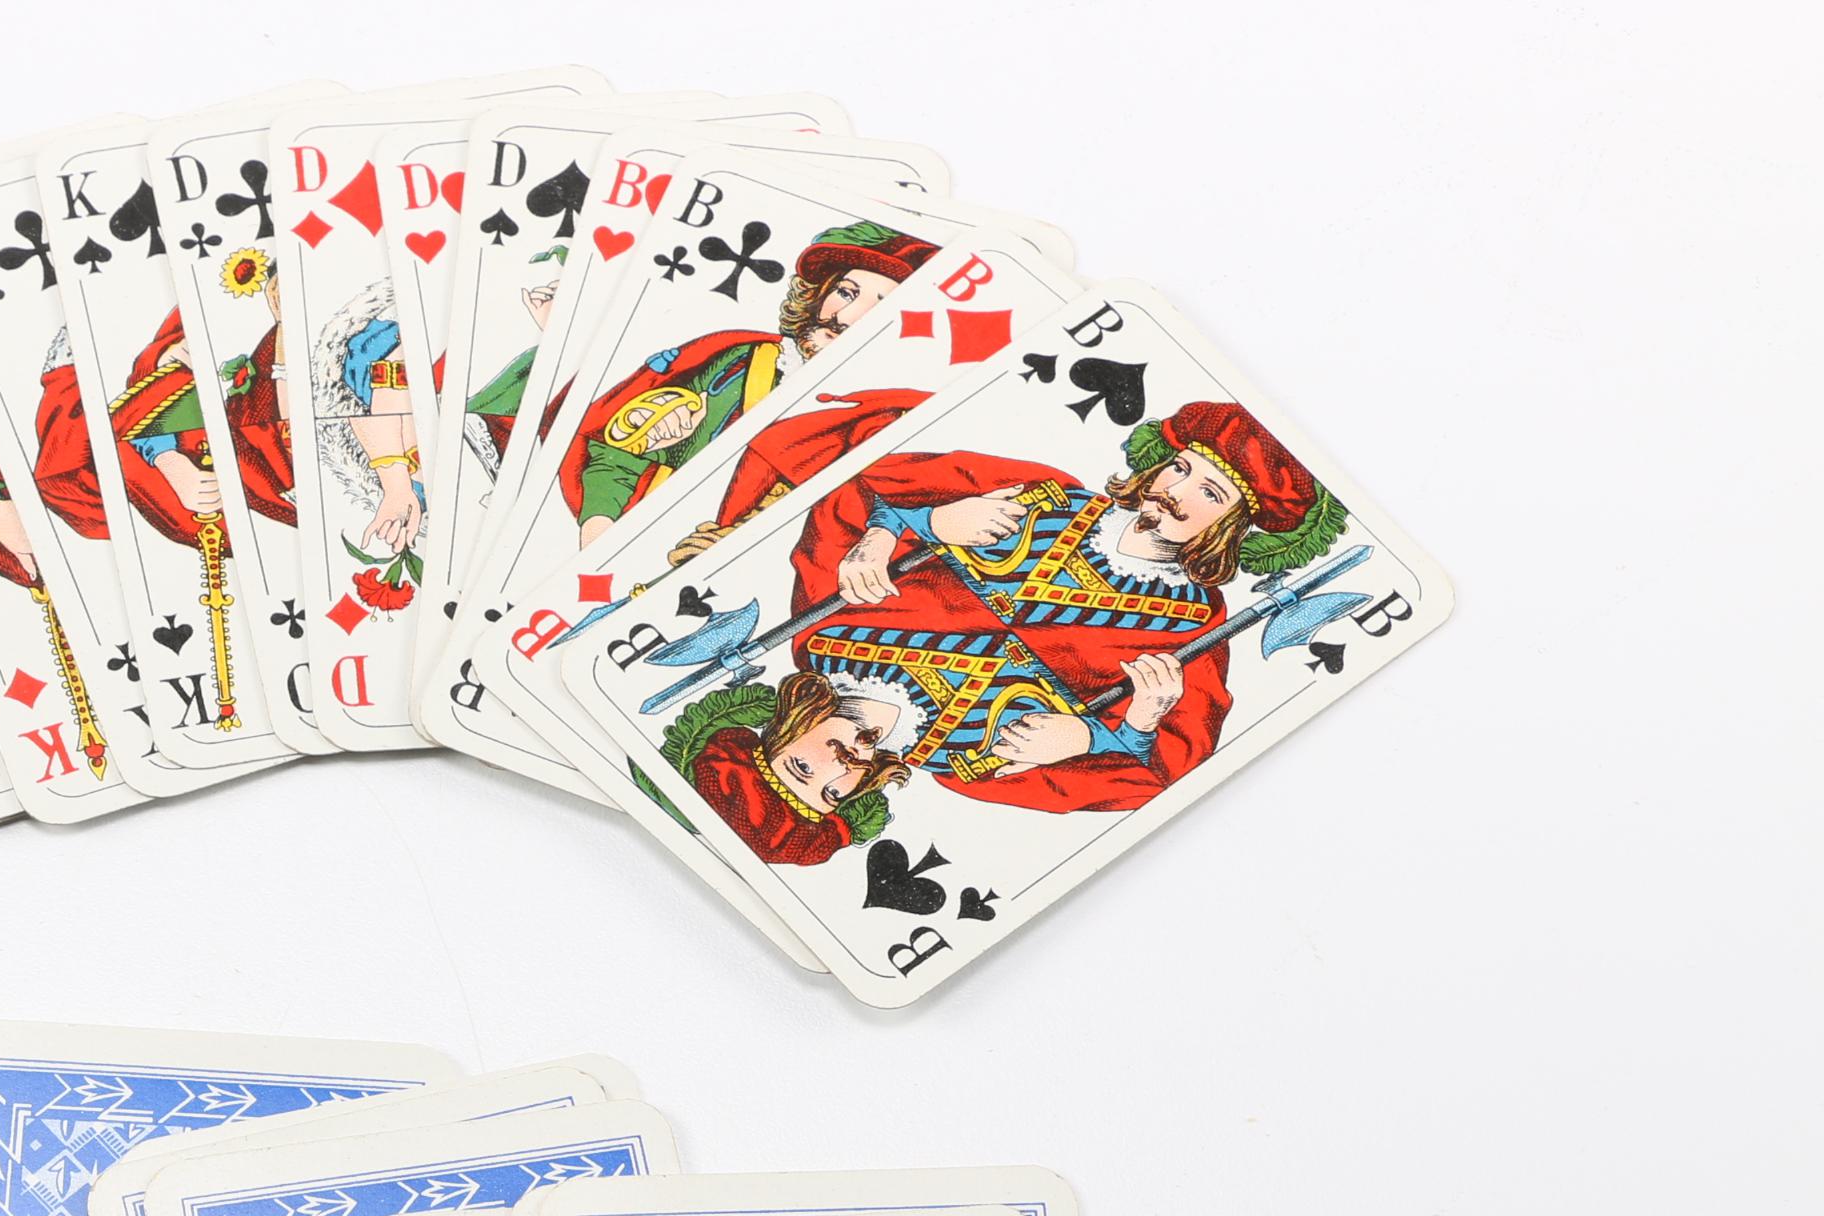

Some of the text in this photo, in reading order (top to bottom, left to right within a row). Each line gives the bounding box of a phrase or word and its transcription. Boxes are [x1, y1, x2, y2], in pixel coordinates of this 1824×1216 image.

[167, 154, 209, 203] D
[287, 145, 329, 194] D
[398, 162, 439, 211] D
[491, 140, 528, 188] D
[603, 159, 647, 209] B
[57, 171, 107, 221] K
[673, 178, 724, 228] B
[937, 253, 994, 303] B
[1063, 301, 1125, 348] B
[511, 608, 571, 662] B
[1351, 589, 1415, 638] B
[607, 622, 668, 672] B
[161, 673, 218, 730] K
[332, 655, 375, 708] D
[21, 721, 79, 784] K
[886, 925, 954, 980] B
